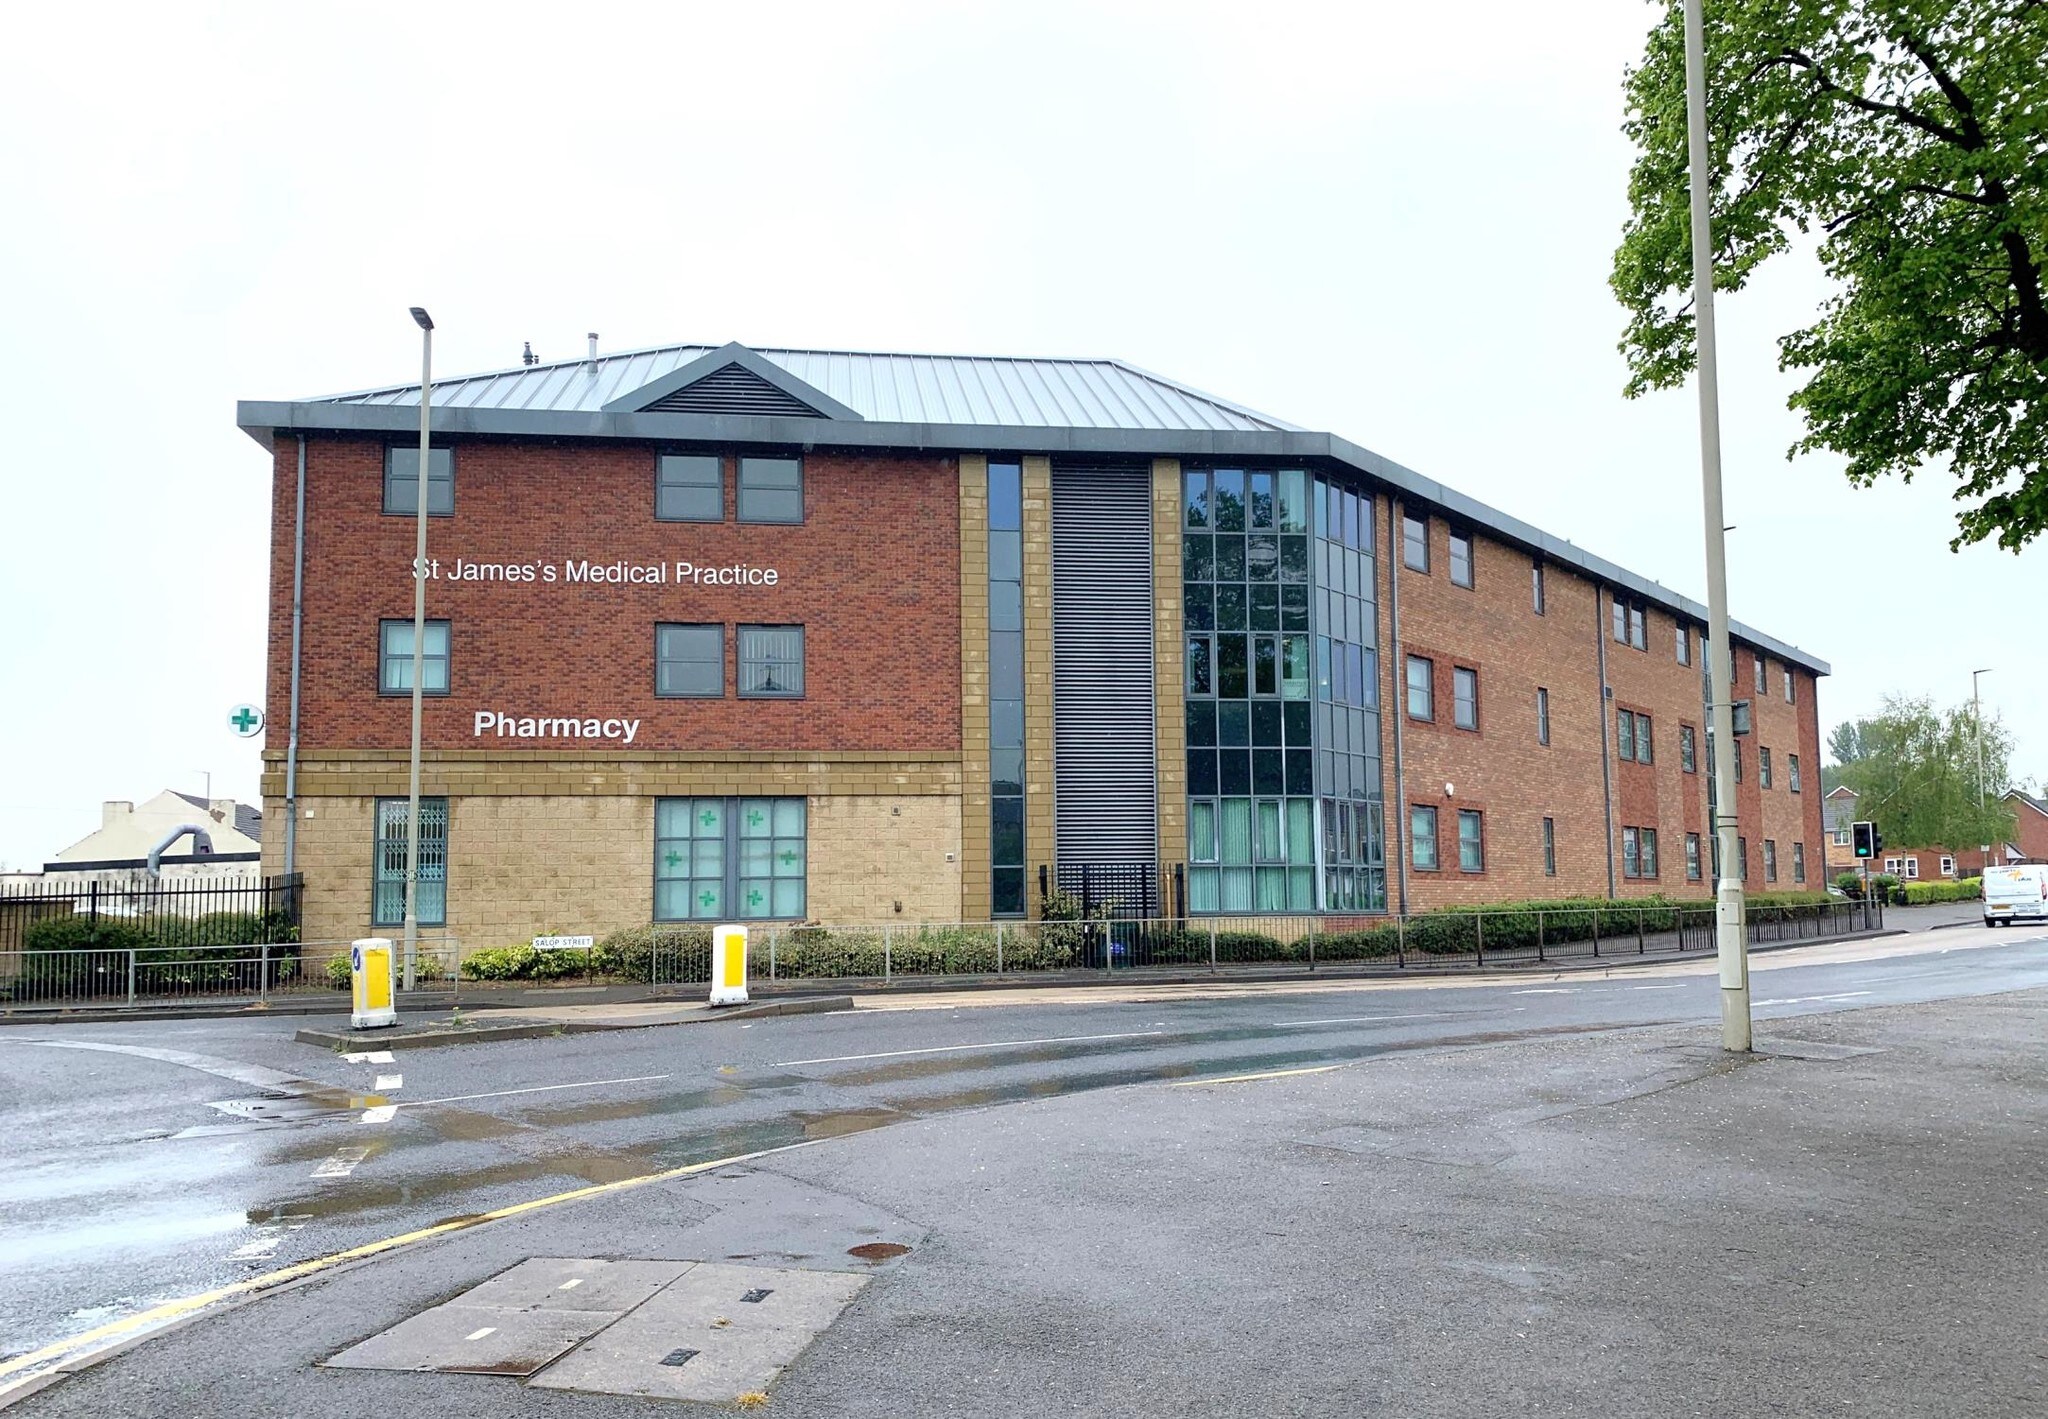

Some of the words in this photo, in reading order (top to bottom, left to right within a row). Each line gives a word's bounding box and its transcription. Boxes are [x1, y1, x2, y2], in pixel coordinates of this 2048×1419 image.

[412, 558, 439, 580] St
[447, 558, 557, 582] James's
[566, 560, 666, 584] Medical
[676, 562, 778, 586] Practice
[474, 711, 640, 744] Pharmacy
[563, 938, 591, 946] STREET
